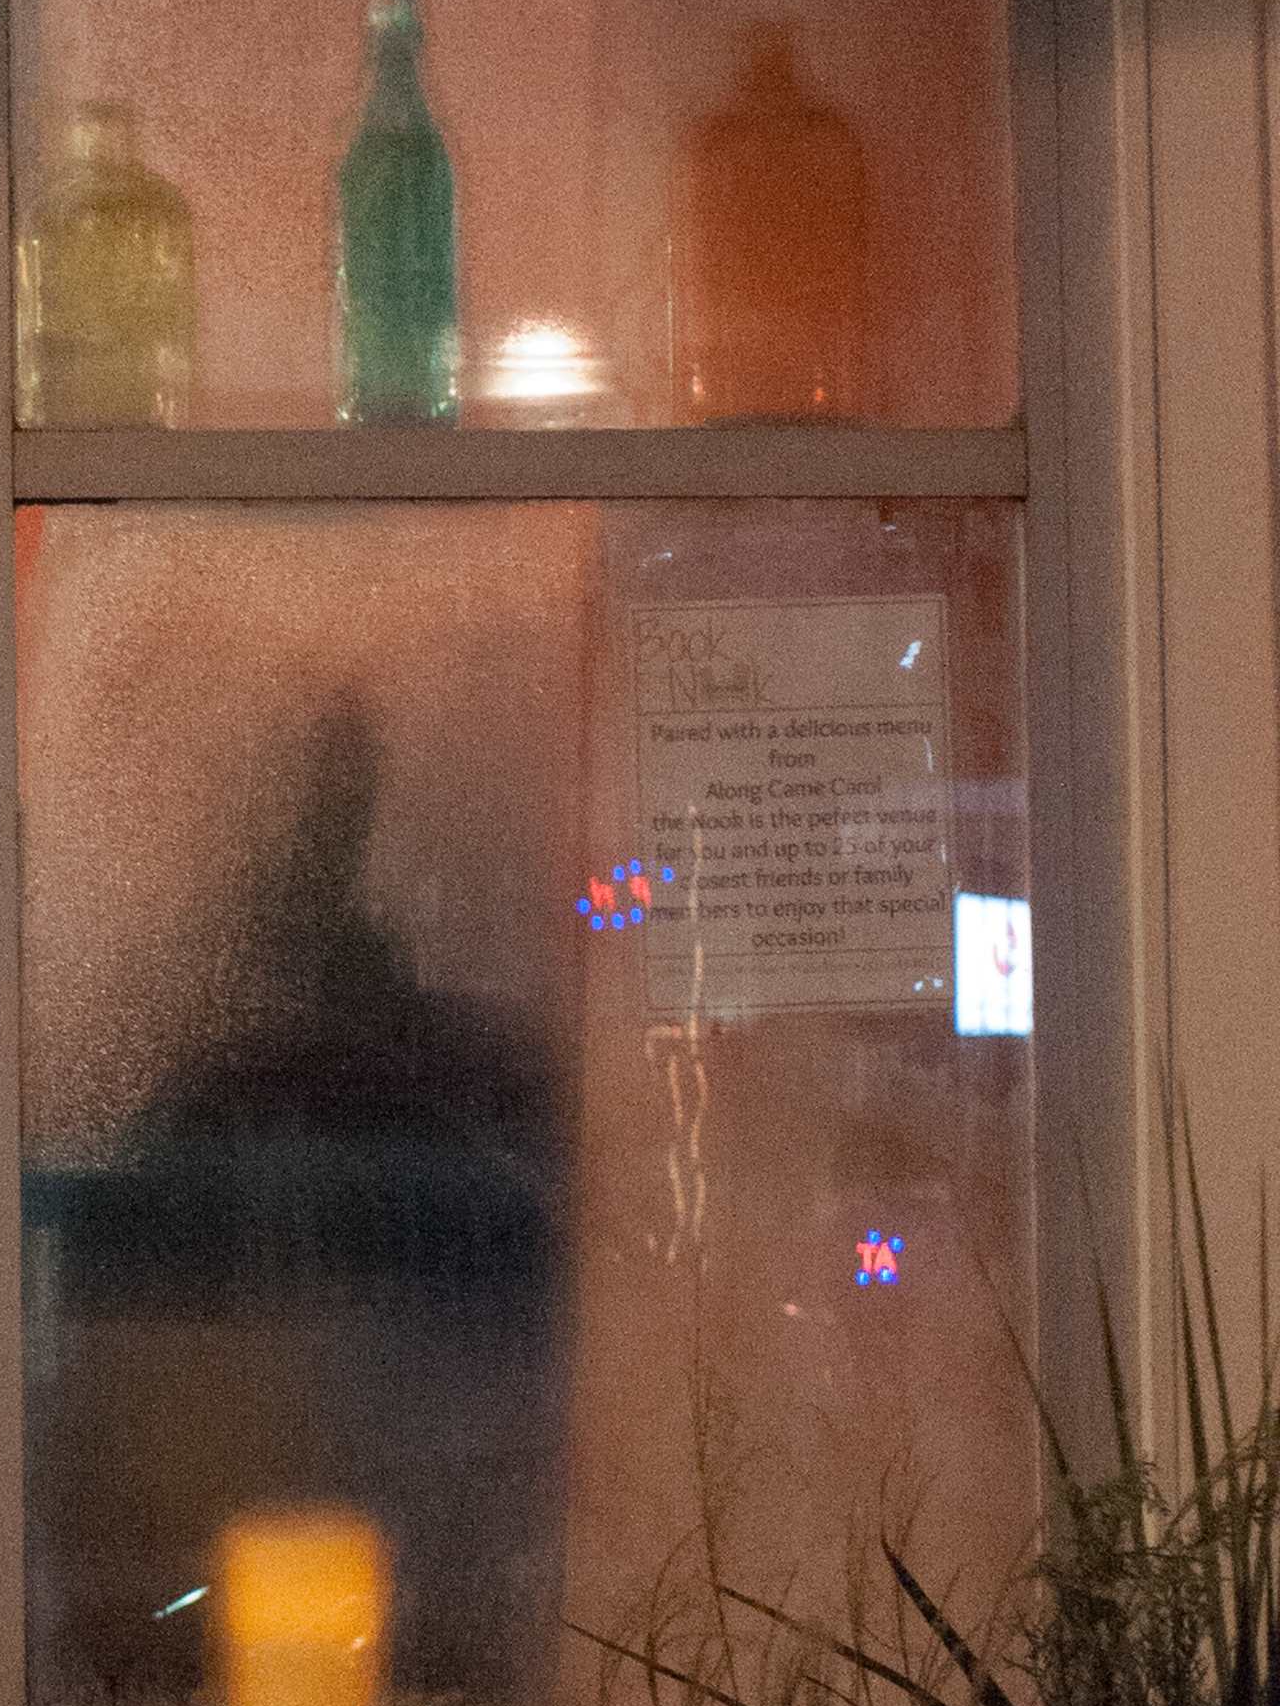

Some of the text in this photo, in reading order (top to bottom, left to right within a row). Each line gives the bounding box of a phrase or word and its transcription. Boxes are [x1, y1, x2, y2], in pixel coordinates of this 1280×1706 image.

[651, 720, 932, 742] Paired with a delicious menu
[769, 749, 815, 768] from
[705, 775, 881, 804] Along Came Carol
[653, 812, 683, 831] the
[749, 813, 763, 828] is
[770, 807, 802, 828] the
[877, 810, 936, 824] venue
[732, 839, 768, 858] and
[775, 842, 800, 863] up
[804, 840, 827, 857] to
[864, 835, 886, 854] of
[890, 838, 937, 859] your
[756, 867, 822, 888] friends
[828, 870, 849, 886] or
[854, 863, 914, 888] family
[746, 901, 767, 918] to
[773, 898, 825, 924] enjoy
[833, 895, 873, 914] that
[878, 890, 946, 918] special
